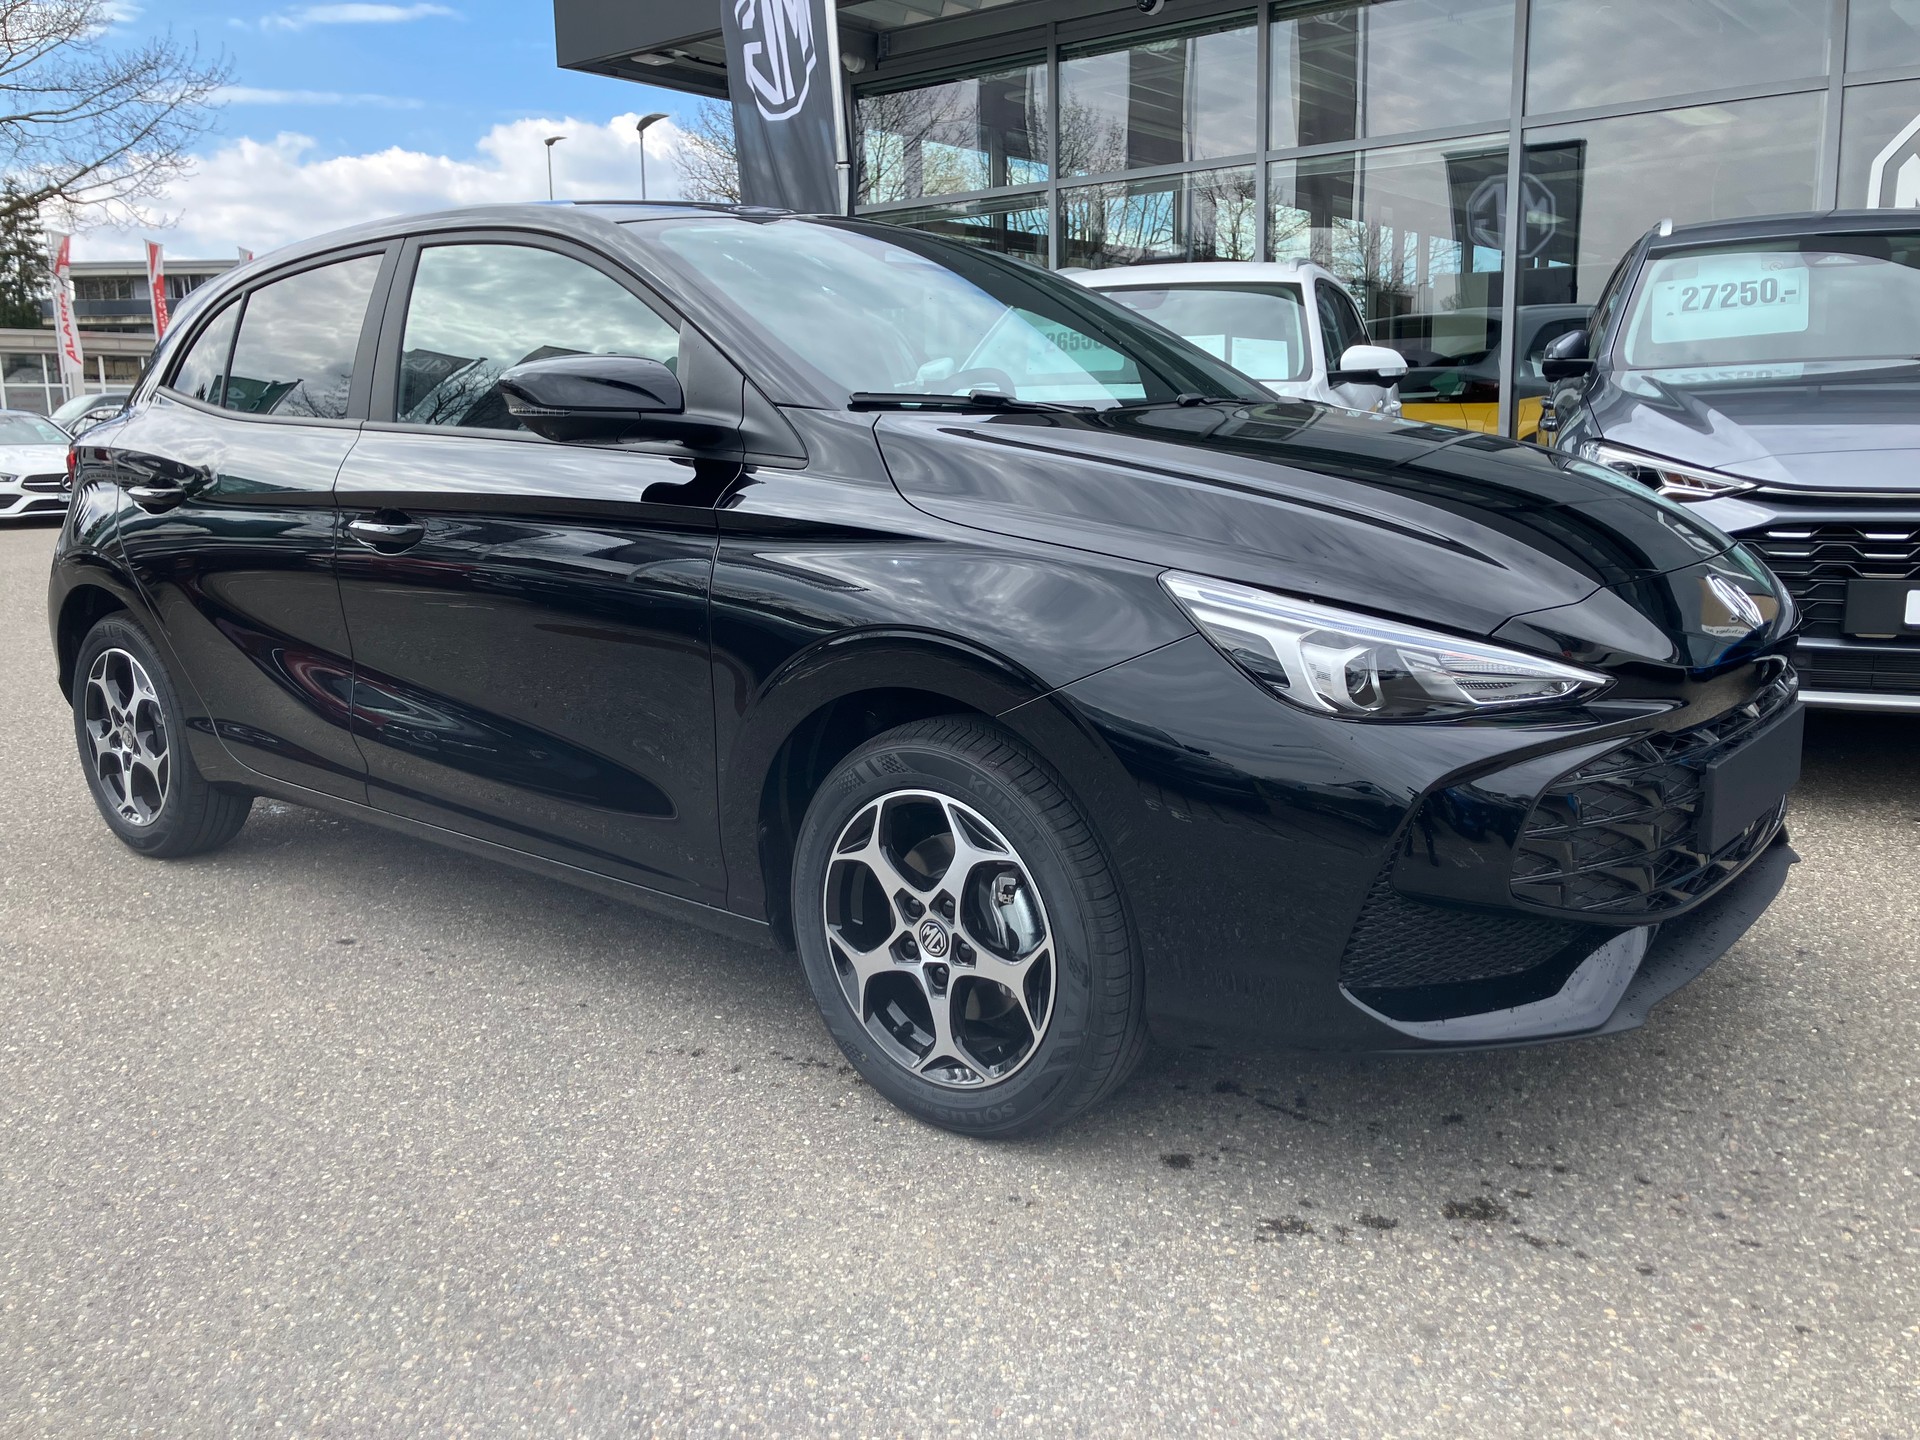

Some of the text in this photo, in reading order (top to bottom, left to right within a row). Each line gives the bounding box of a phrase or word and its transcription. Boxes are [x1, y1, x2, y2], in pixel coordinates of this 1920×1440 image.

[1681, 277, 1797, 312] 27250.-
[968, 774, 1050, 863] KUMHO
[921, 925, 945, 953] MG
[934, 1102, 1018, 1124] SOLUS
